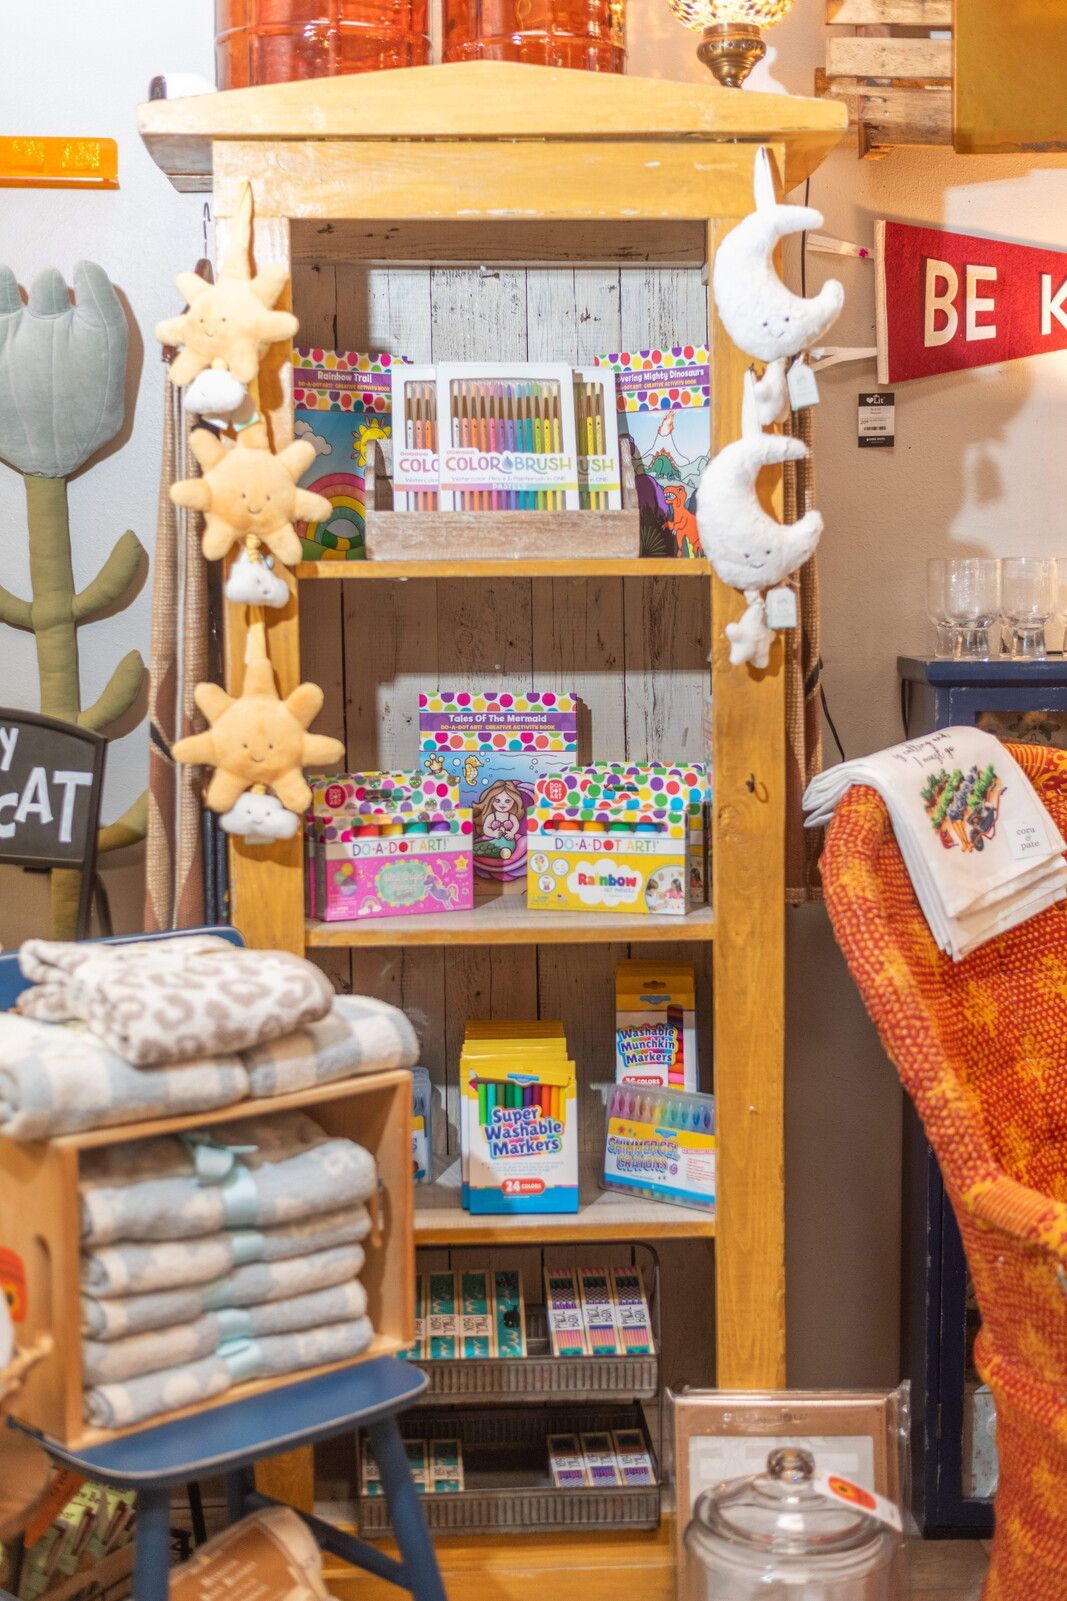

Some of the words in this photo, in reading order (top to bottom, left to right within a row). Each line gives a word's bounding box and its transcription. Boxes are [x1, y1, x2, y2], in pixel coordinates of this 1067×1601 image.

[924, 257, 998, 348] BE
[318, 371, 353, 382] Rainbow
[354, 373, 372, 383] Trail
[644, 372, 669, 381] Mighty
[669, 368, 704, 378] Dinosaurs
[400, 458, 438, 473] COLO
[445, 456, 513, 475] COLOR
[514, 456, 572, 475] BRUSH
[578, 458, 614, 475] USH
[449, 714, 473, 723] Tales
[475, 714, 487, 723] Of
[489, 714, 505, 723] The
[508, 714, 547, 723] Mermaid
[420, 838, 447, 852] ART!
[626, 840, 656, 852] ART!
[578, 872, 637, 887] Rainbow
[621, 1025, 674, 1039] Washable
[620, 1039, 675, 1052] Munchkin
[626, 1051, 672, 1065] Markers
[492, 1107, 539, 1124] Super
[485, 1120, 562, 1140] Washable
[492, 1137, 559, 1157] Markers
[505, 1180, 520, 1192] 24
